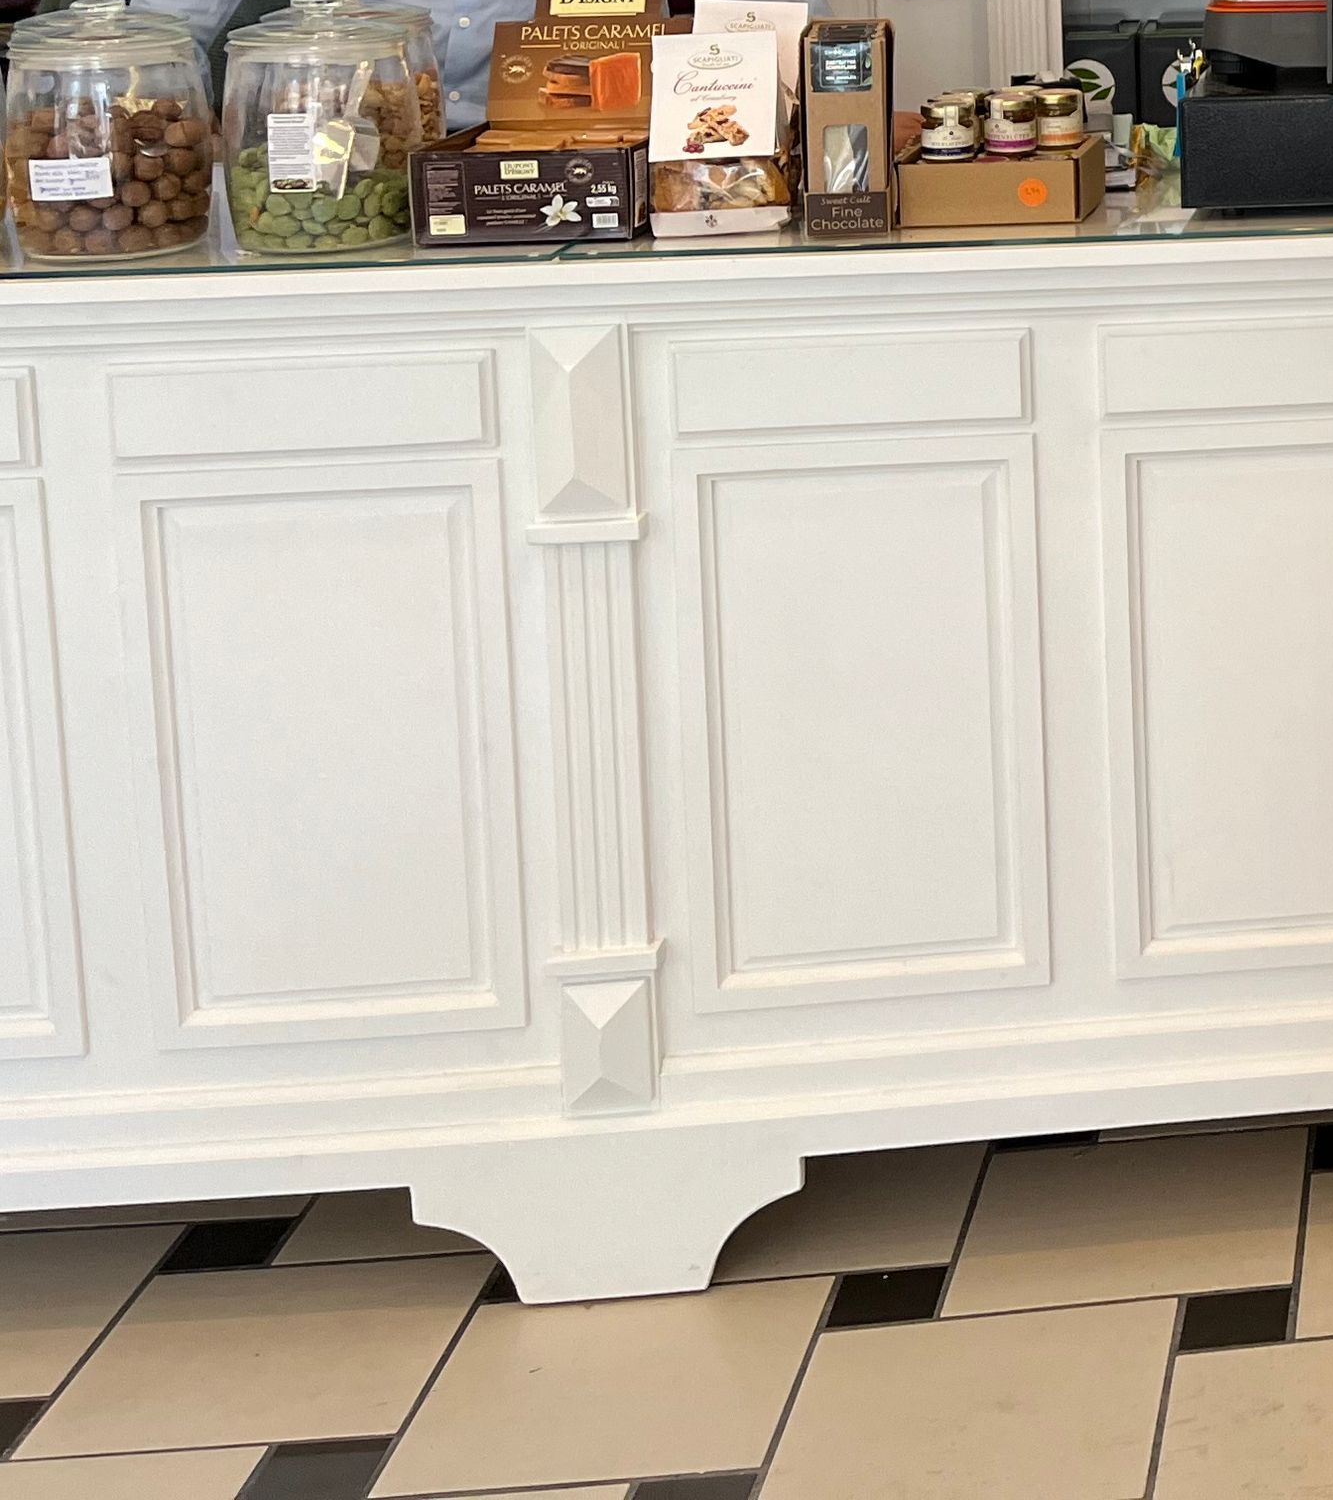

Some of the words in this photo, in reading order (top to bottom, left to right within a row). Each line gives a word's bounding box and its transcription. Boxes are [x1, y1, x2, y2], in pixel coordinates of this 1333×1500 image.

[730, 22, 771, 30] SCAPIGLIATI
[521, 25, 580, 40] PALETS
[693, 55, 738, 63] SCAPIGLIATI
[674, 70, 753, 95] Cantuccini
[474, 184, 512, 194] PALETS
[514, 182, 567, 193] CARAMEL
[591, 185, 606, 194] 2,55
[608, 185, 616, 194] kg
[821, 197, 847, 205] Sweet
[832, 207, 862, 217] Fine
[811, 218, 883, 230] Chocolate
